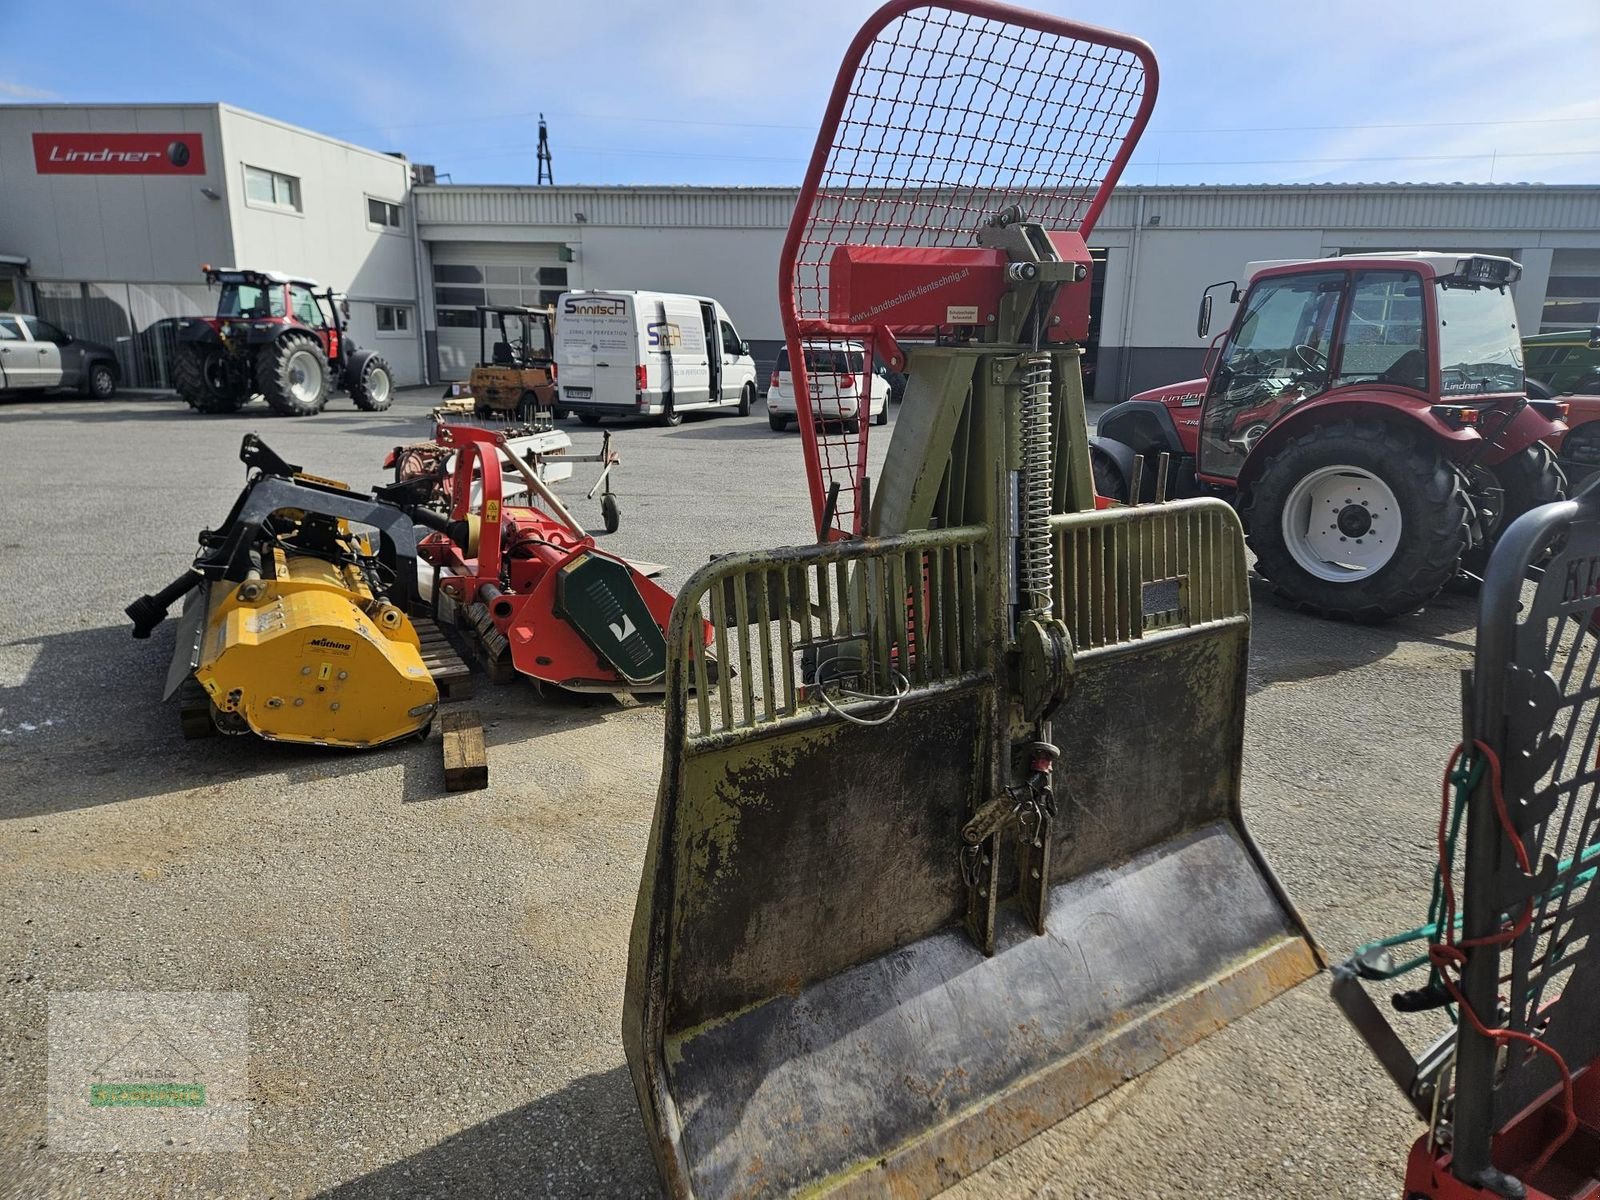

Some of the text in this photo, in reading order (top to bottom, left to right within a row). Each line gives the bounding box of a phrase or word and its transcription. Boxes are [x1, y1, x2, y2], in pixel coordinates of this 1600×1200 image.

[49, 145, 161, 162] Lindner
[850, 267, 970, 323] www.landtechnik-lientschnig.at
[1443, 382, 1482, 391] Lindner
[309, 637, 352, 651] Müthing
